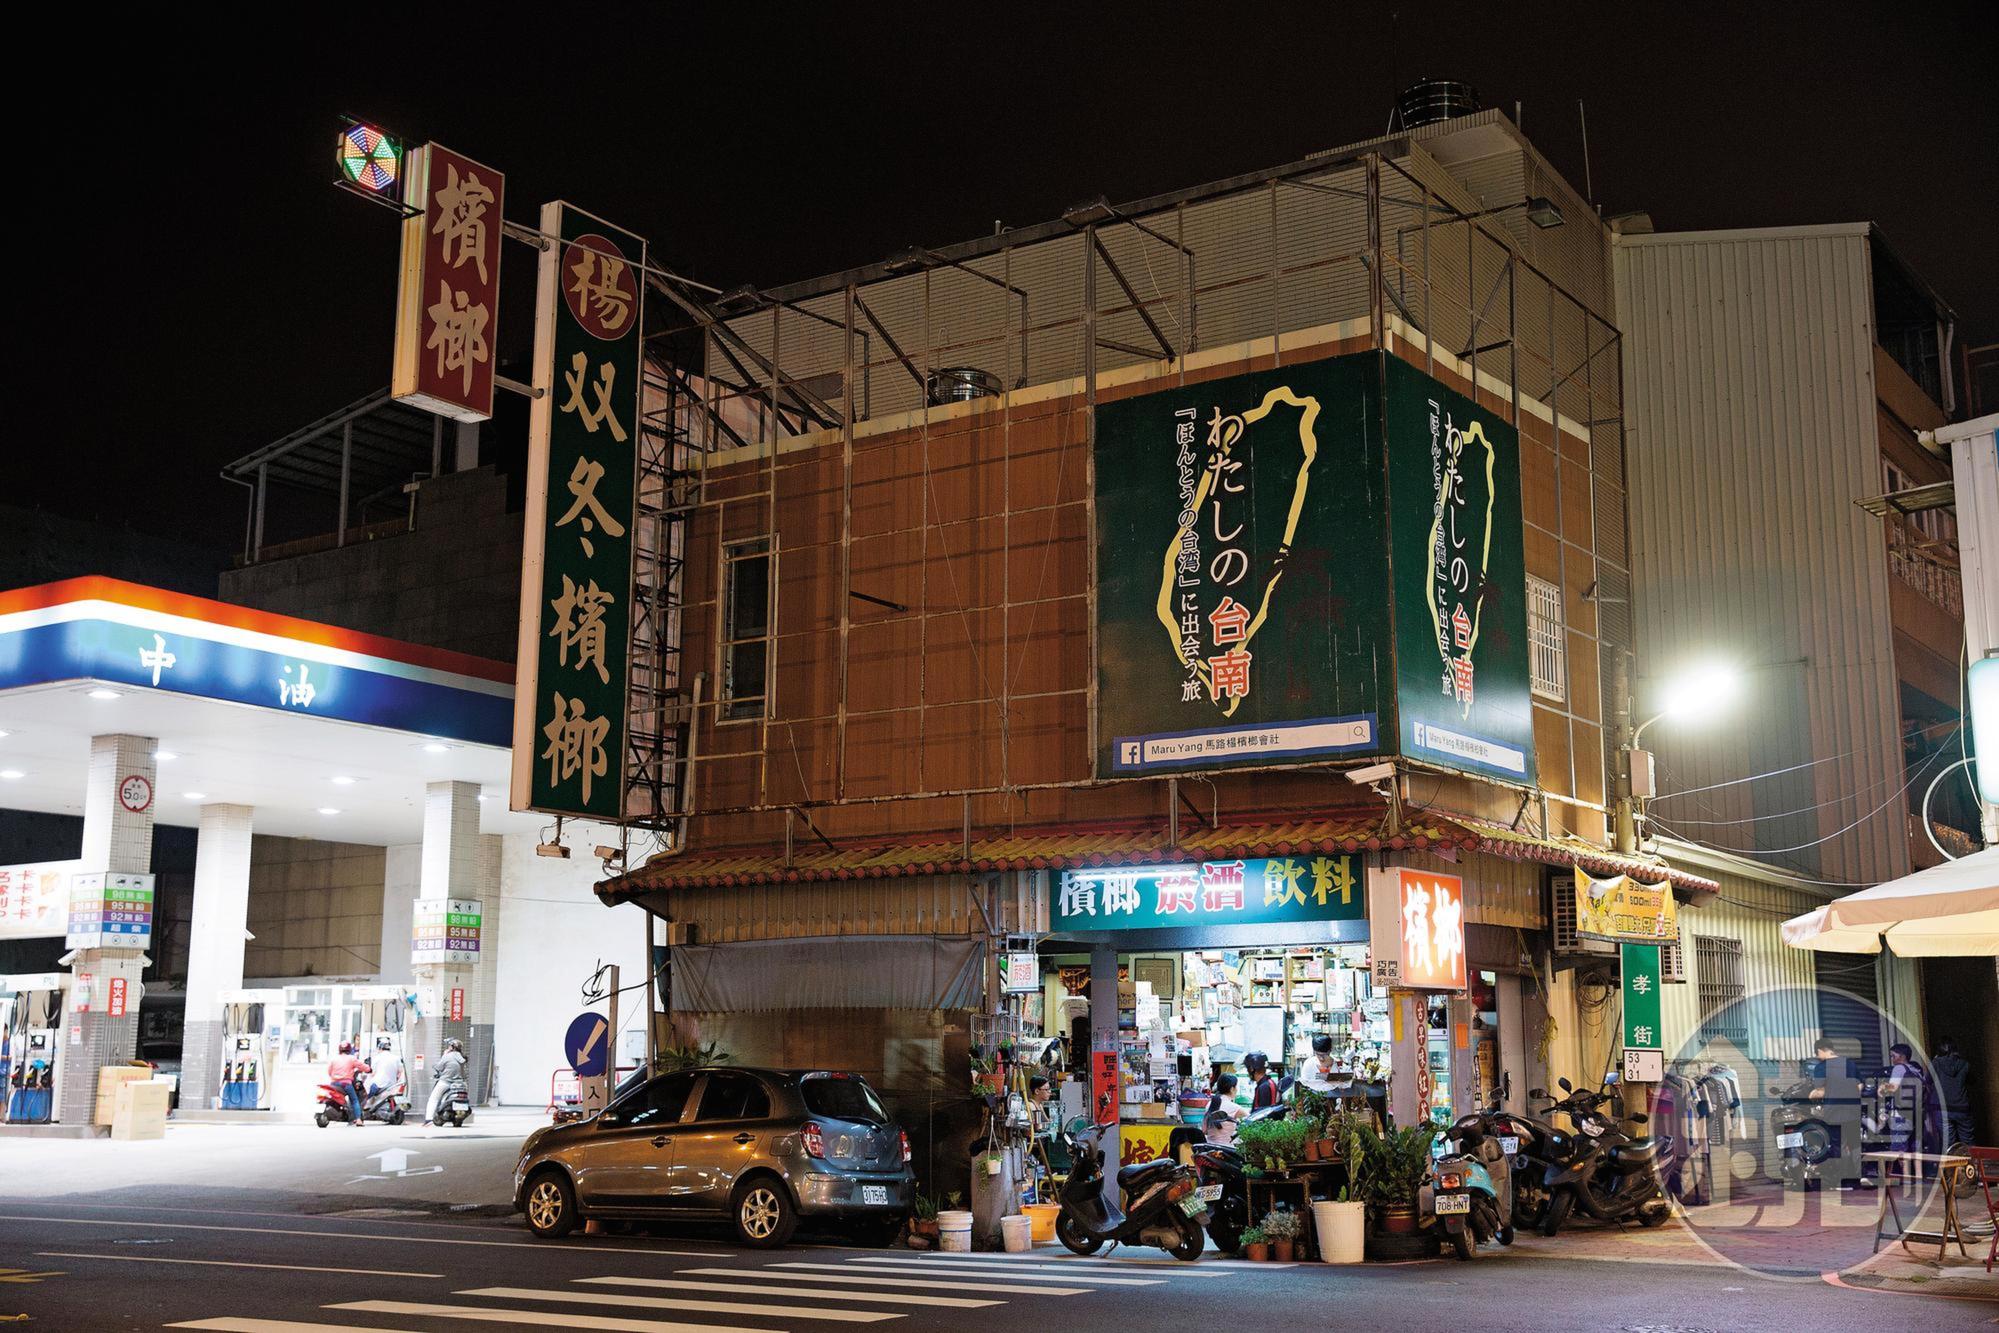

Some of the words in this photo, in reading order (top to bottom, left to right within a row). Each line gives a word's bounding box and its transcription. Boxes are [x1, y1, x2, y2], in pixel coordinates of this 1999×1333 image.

[426, 162, 495, 398] 檳榔
[1206, 405, 1253, 700] わたしの台南
[139, 632, 317, 708] 中油
[1151, 743, 1176, 755] Maru
[1178, 742, 1203, 754] Yang
[1262, 854, 1356, 908] 飲料
[1628, 1052, 1640, 1064] 53
[1628, 1069, 1640, 1081] 31
